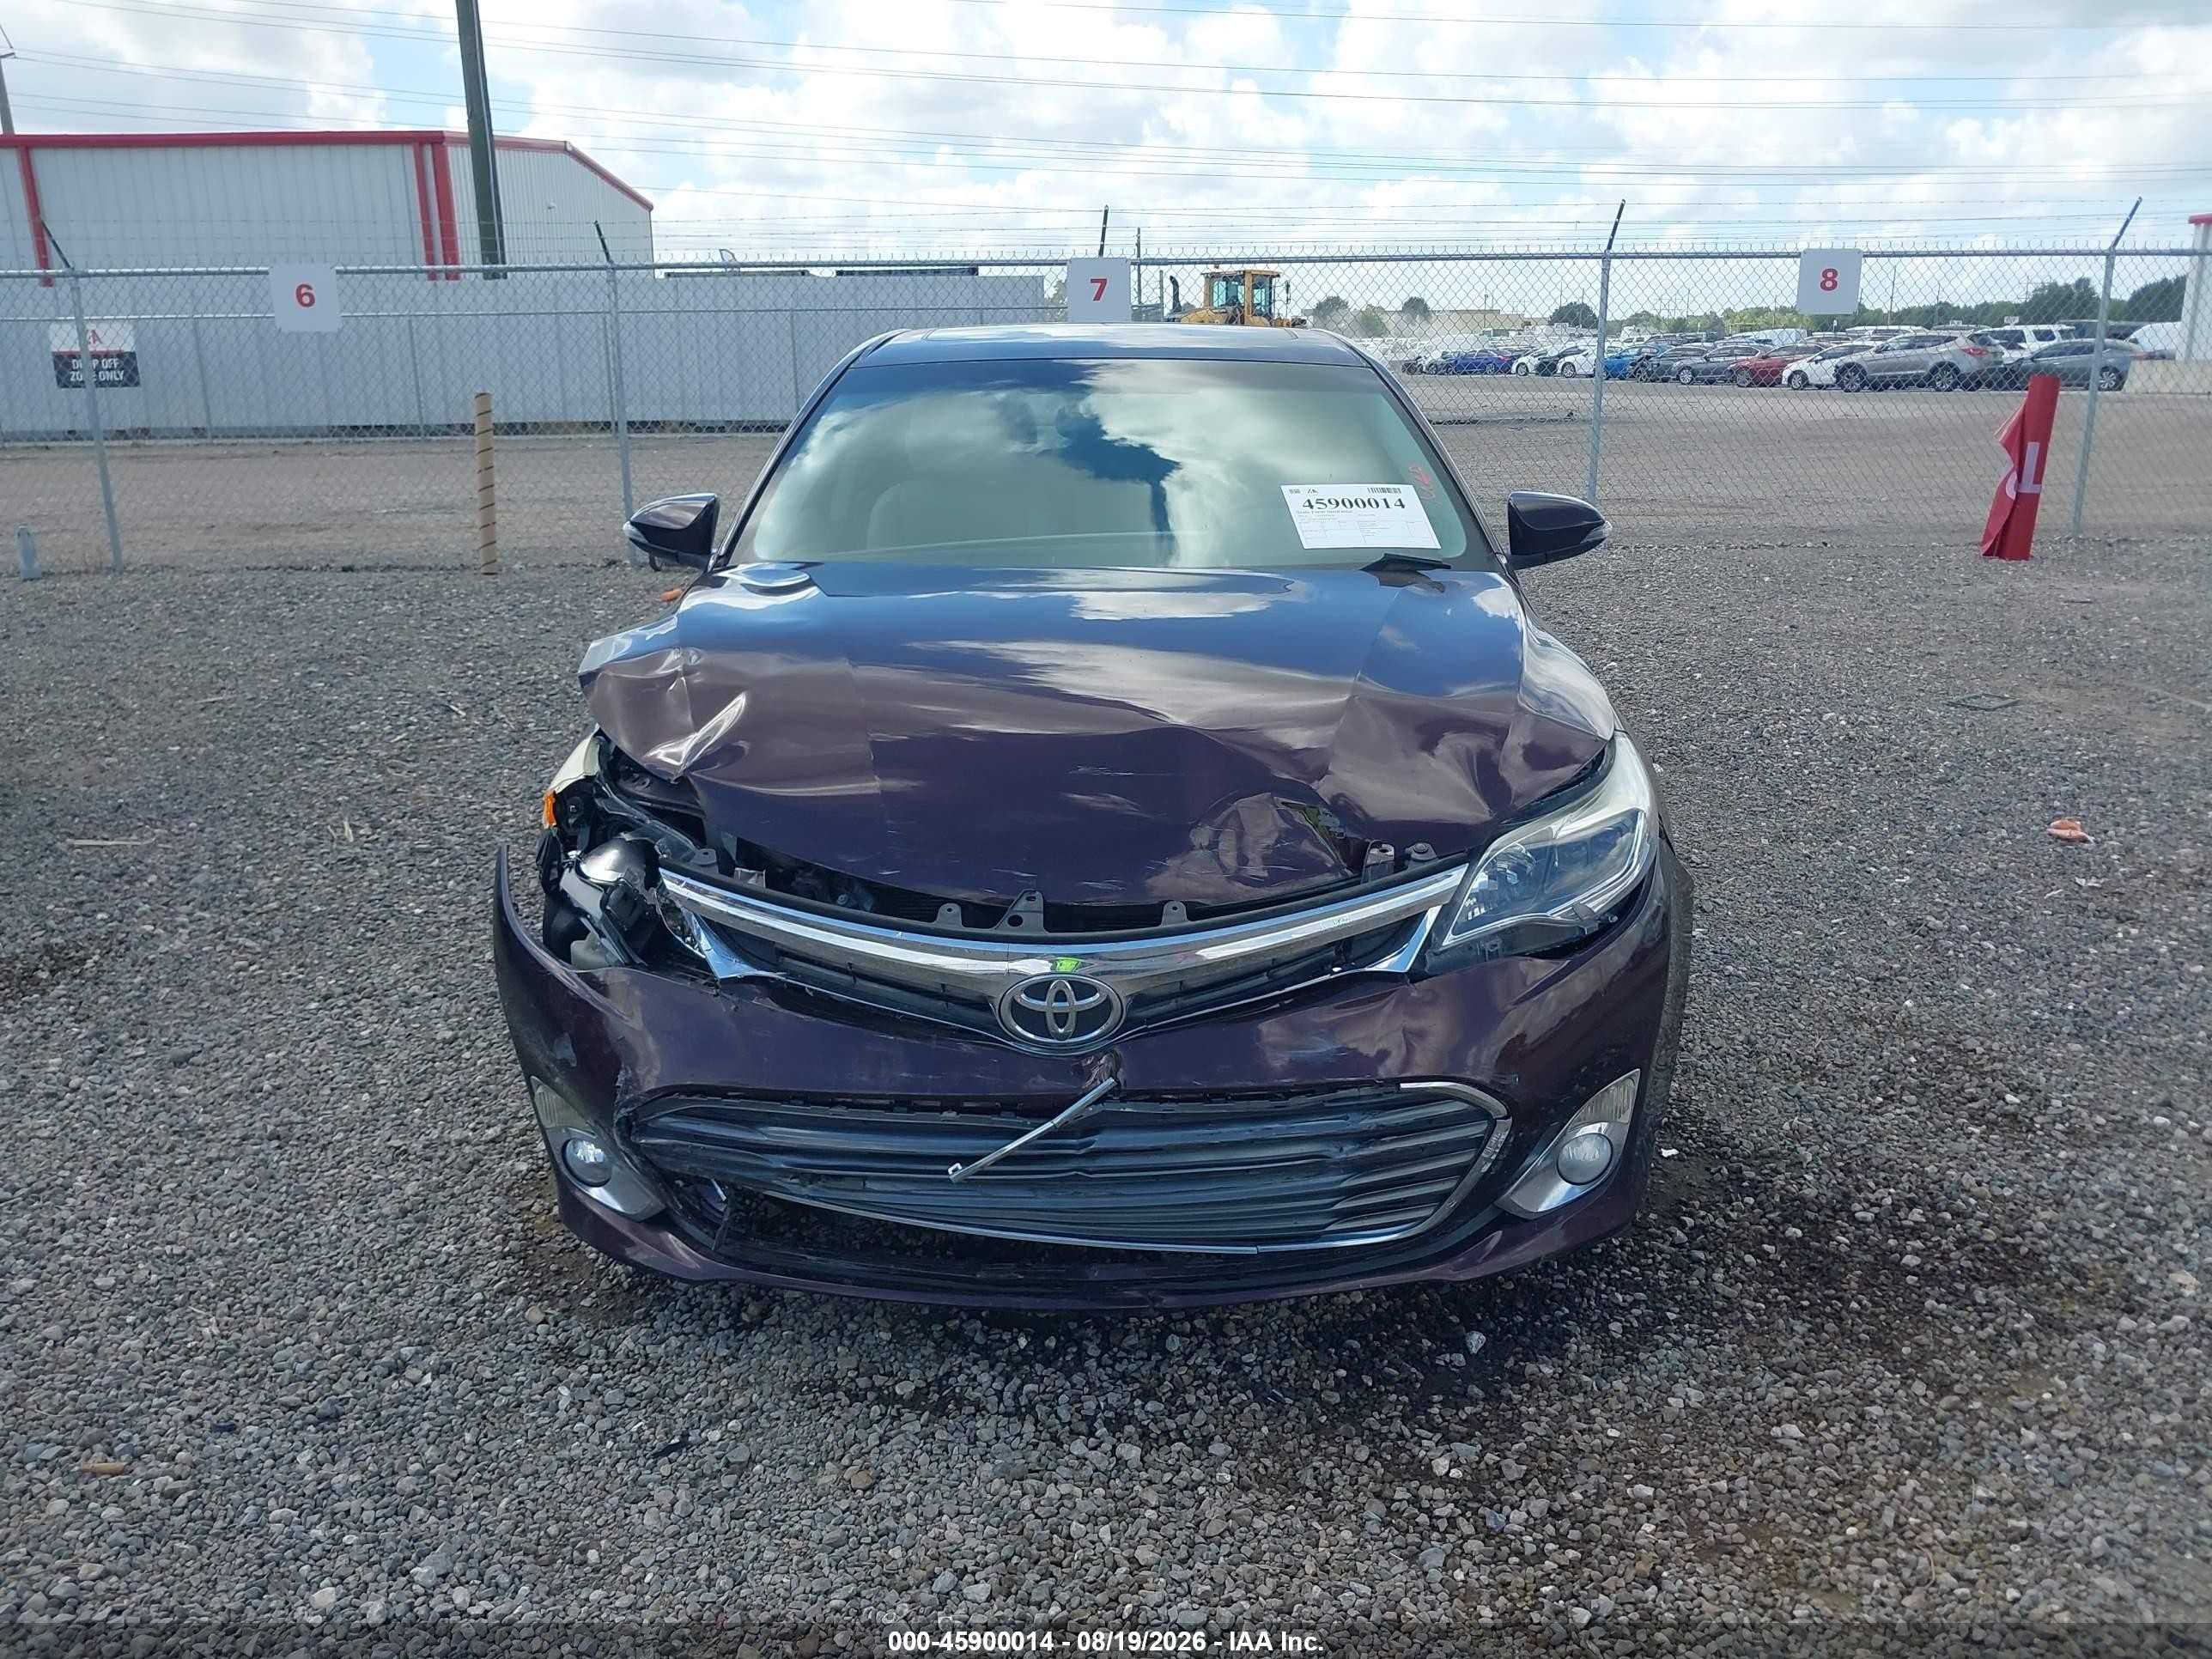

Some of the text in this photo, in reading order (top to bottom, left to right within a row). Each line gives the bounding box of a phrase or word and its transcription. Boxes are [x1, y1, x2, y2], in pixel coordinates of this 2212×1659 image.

[1820, 268, 1838, 292] 8
[295, 283, 316, 307] 6
[1090, 278, 1108, 301] 7
[71, 359, 119, 370] DP OFF
[70, 370, 125, 382] ZOE ONLY
[1302, 497, 1406, 510] 45900014
